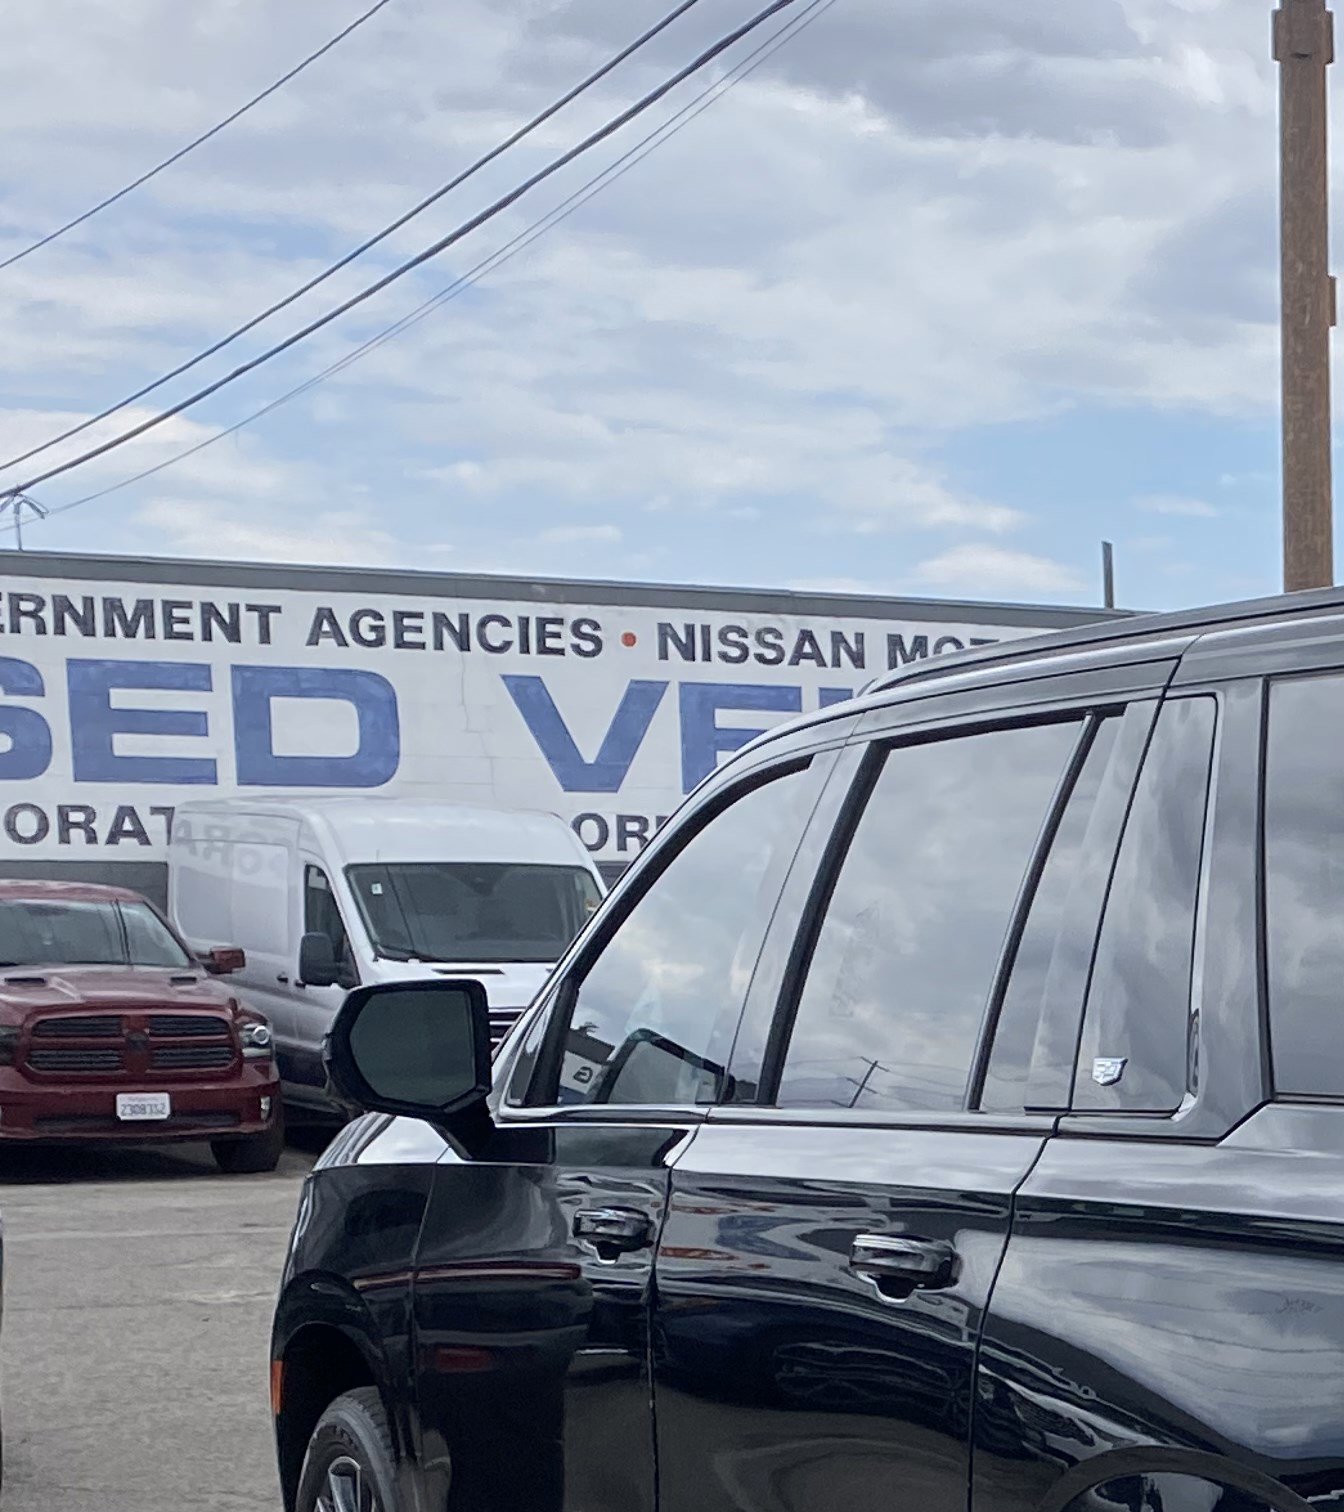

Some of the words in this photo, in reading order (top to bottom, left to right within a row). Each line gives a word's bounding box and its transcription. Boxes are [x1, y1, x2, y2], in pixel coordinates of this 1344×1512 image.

[0, 591, 281, 645] RNMENT
[306, 607, 603, 659] AGENCIES
[657, 622, 865, 670] NISSAN
[500, 674, 853, 795] VE
[570, 812, 669, 852] OR
